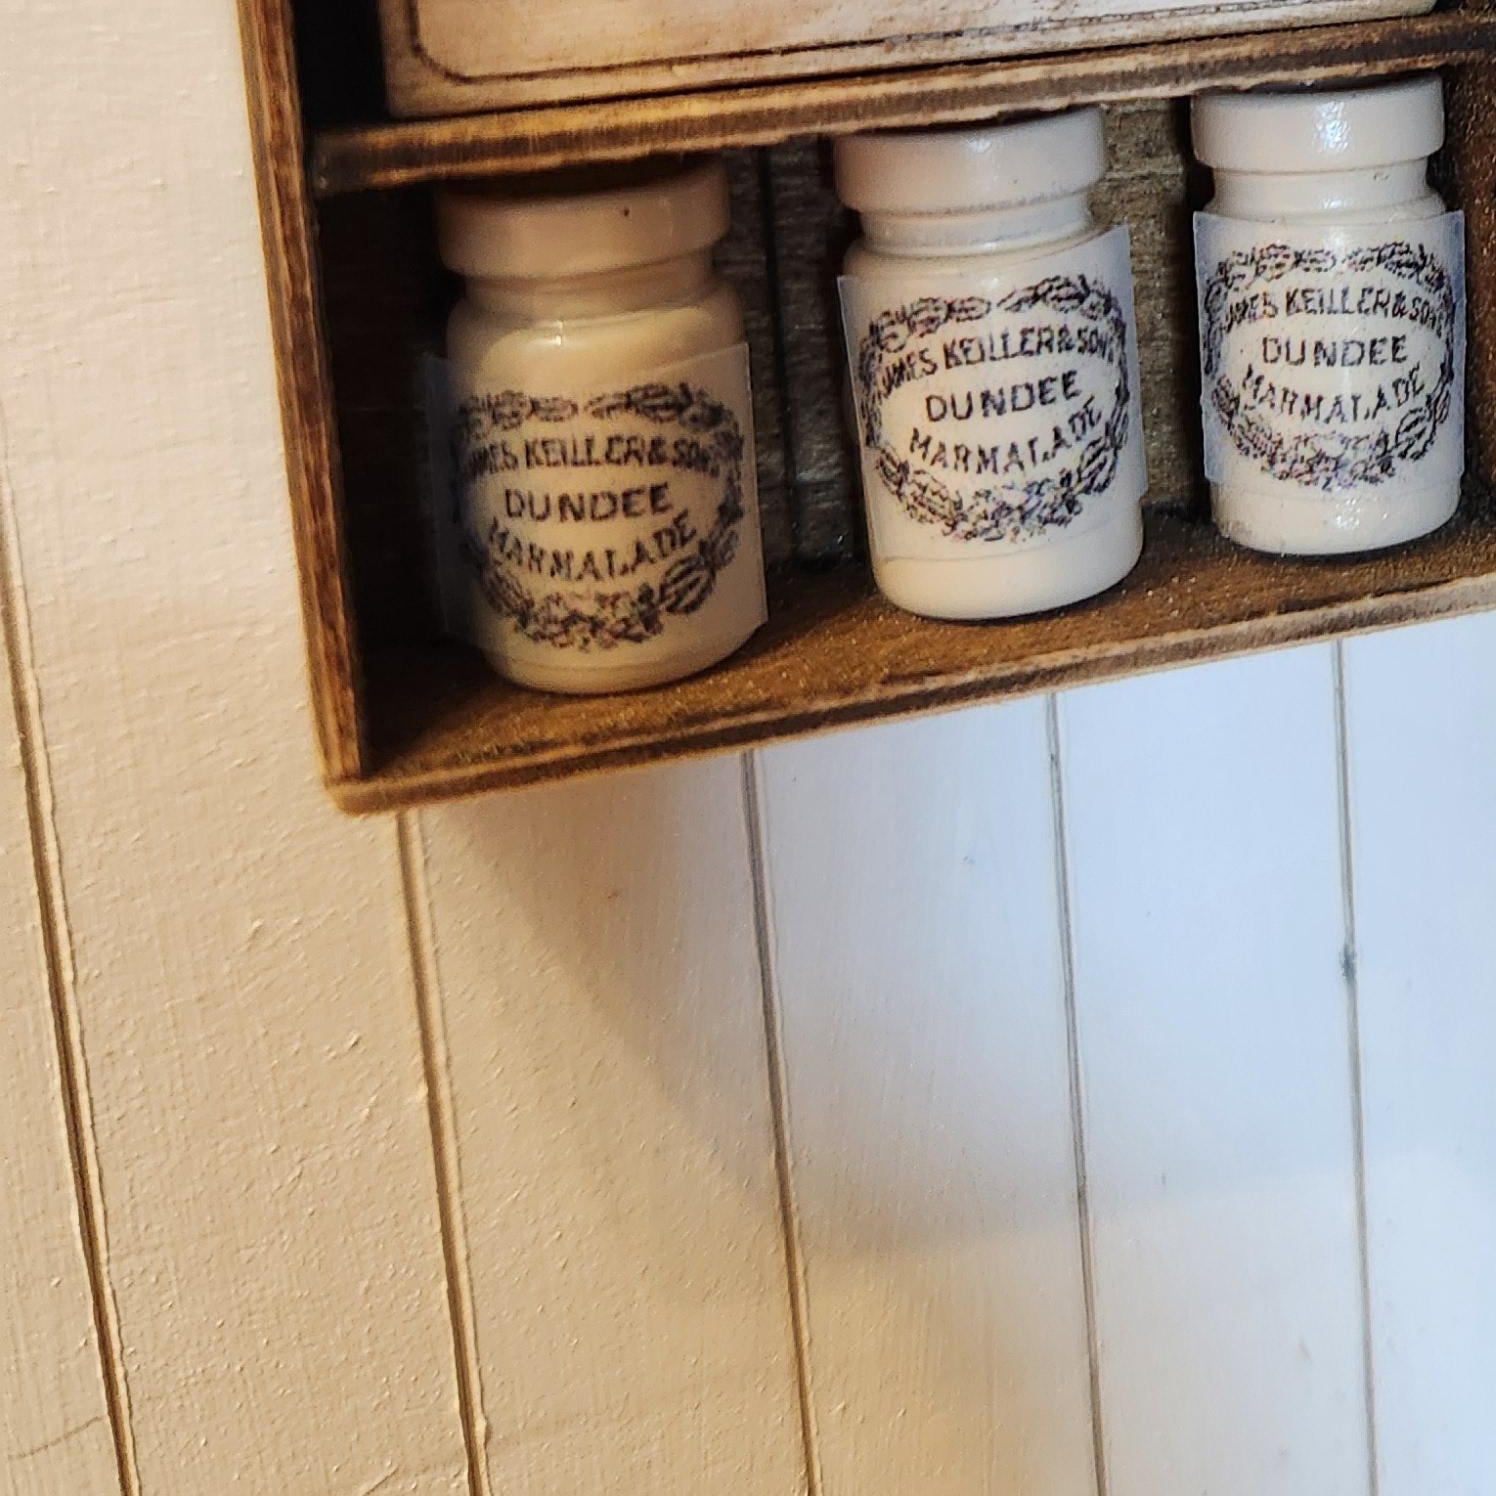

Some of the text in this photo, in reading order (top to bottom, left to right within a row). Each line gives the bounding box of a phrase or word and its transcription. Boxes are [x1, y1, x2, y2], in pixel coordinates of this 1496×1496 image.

[1262, 335, 1409, 368] DUNDEE
[925, 370, 1083, 423] DUNDEE
[1241, 362, 1425, 425] MARMALADE
[909, 396, 1102, 476] MARMALADE
[504, 482, 674, 523] DUNDEE
